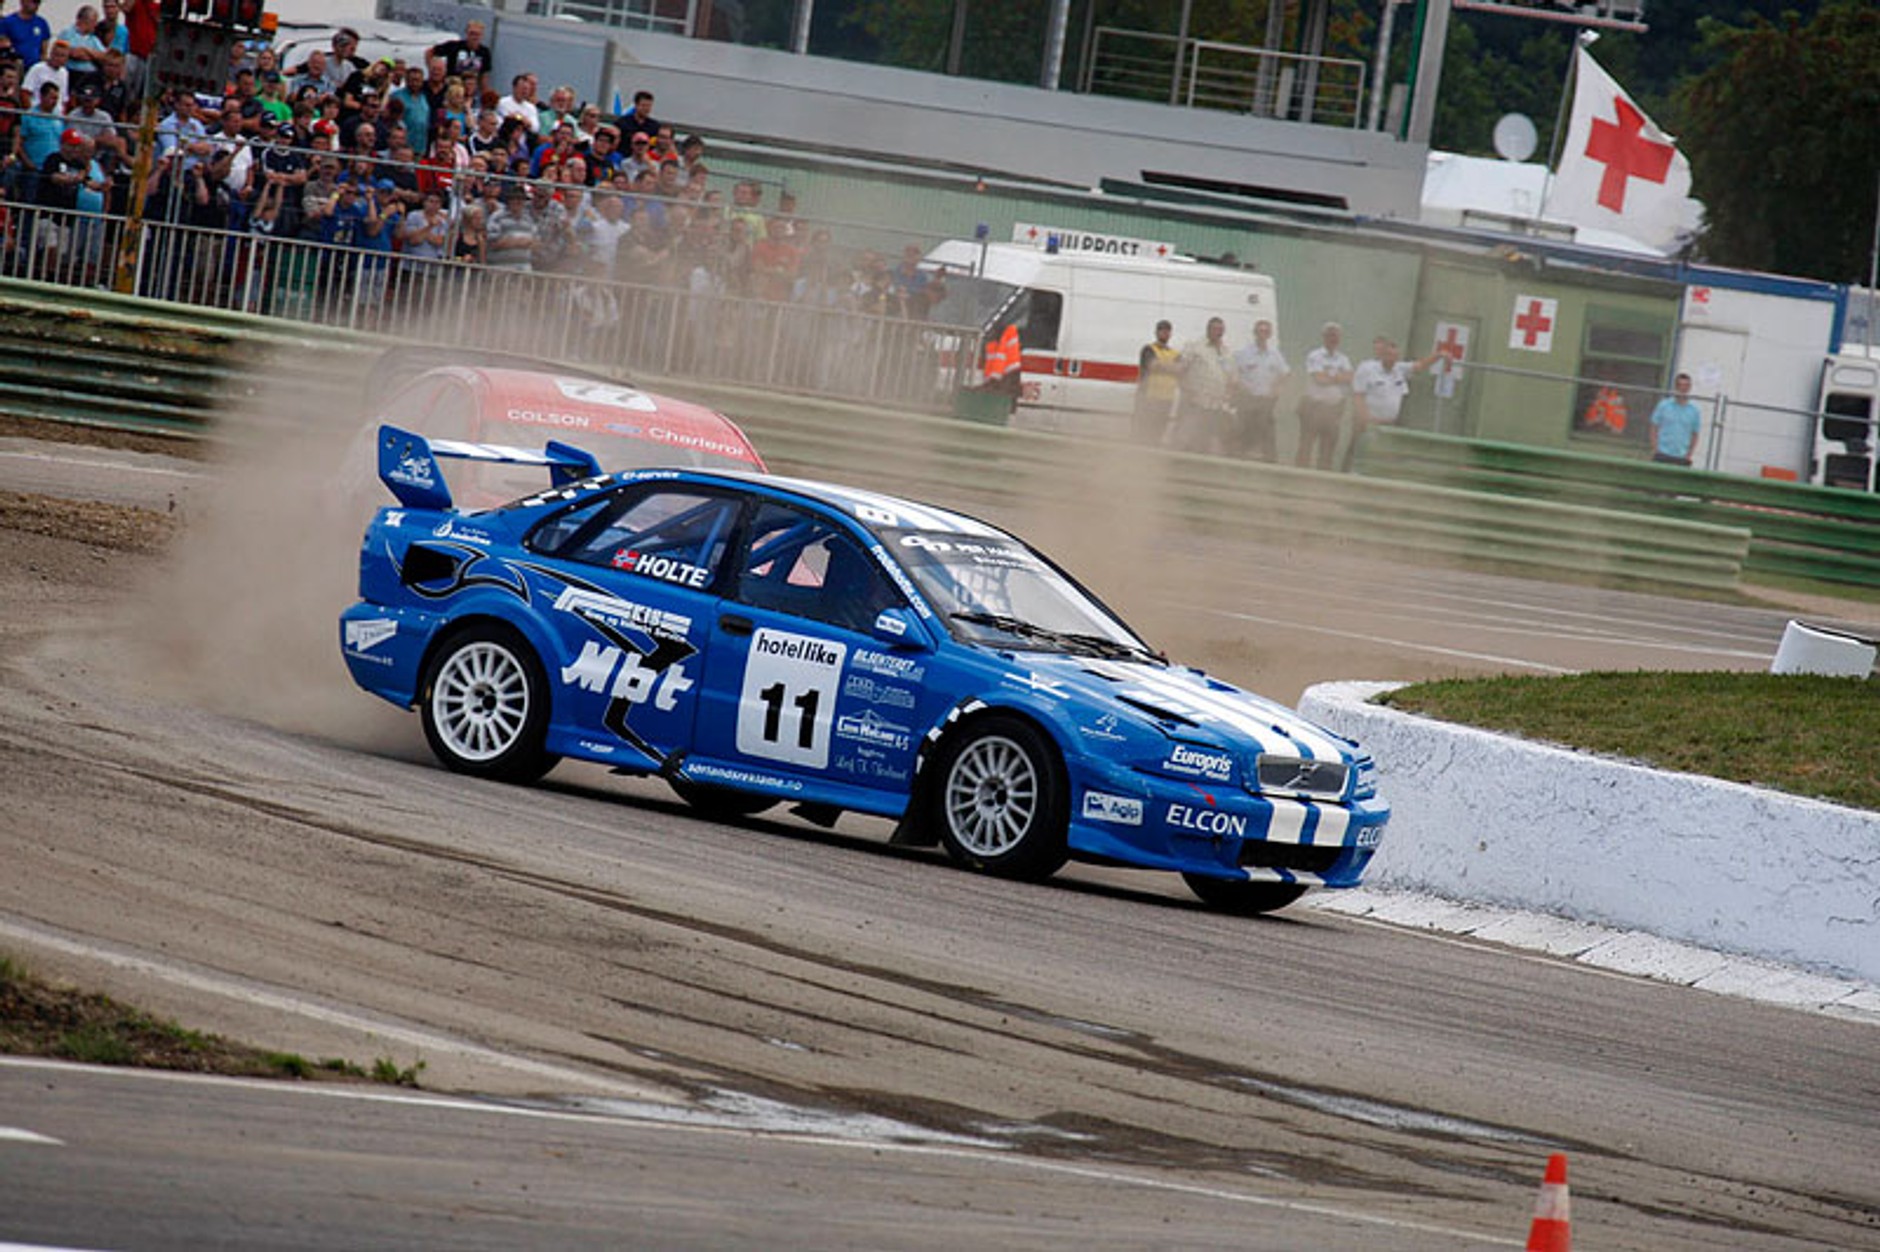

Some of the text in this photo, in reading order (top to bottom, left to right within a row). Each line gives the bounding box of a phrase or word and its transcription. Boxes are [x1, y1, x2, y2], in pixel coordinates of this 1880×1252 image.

[507, 409, 590, 428] COLSON
[634, 554, 709, 588] HOLTE
[759, 681, 820, 750] 11
[1170, 744, 1234, 776] Europris
[1110, 801, 1140, 820] Agip
[1165, 803, 1248, 838] ELCON
